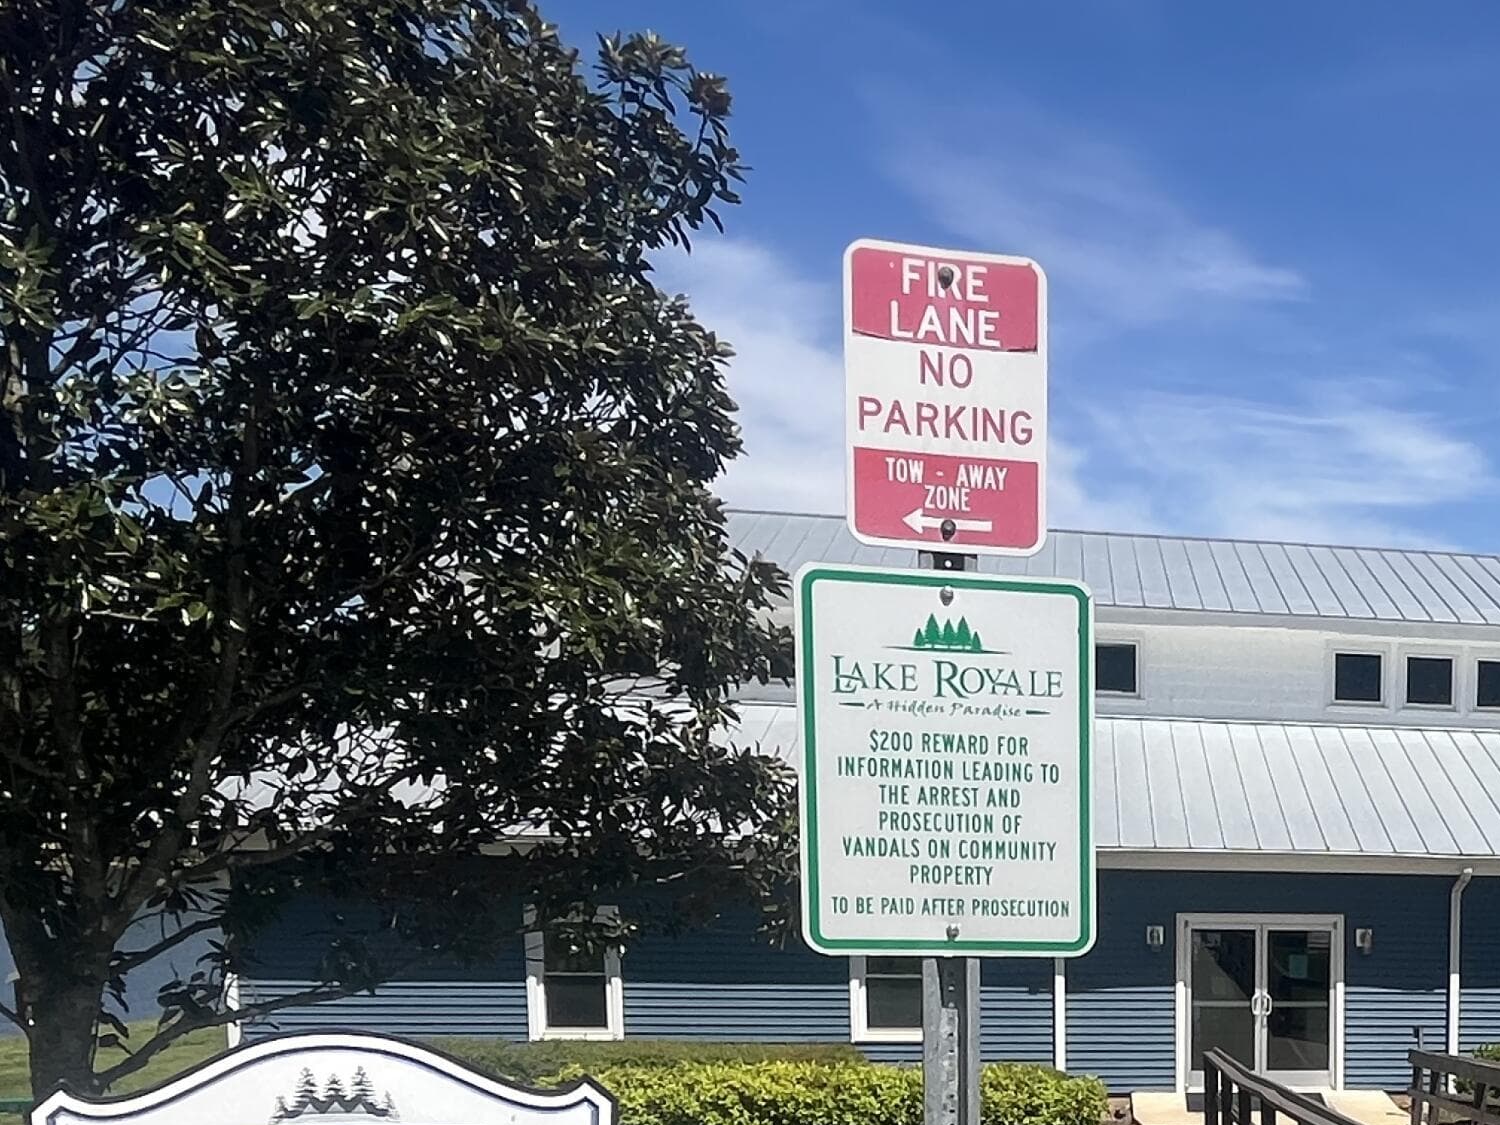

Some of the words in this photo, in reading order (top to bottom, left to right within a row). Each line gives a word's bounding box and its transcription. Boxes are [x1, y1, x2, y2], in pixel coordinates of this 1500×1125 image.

[902, 258, 989, 302] FIRE
[890, 300, 1000, 347] LANE
[920, 350, 973, 389] NO
[858, 396, 1033, 445] PARKING
[885, 457, 923, 484] TOW
[956, 466, 1008, 491] AWAY
[924, 485, 970, 512] ZONE
[831, 654, 918, 694] LAKE
[933, 659, 1064, 699] ROYALE
[949, 704, 1021, 719] Paradise
[869, 729, 913, 752] $200
[922, 734, 989, 755] REWARD
[999, 736, 1028, 757] FOR
[837, 756, 953, 780] INFORMATION
[962, 761, 1033, 782] LEADING
[1041, 764, 1060, 784] TO
[879, 784, 909, 805] THE
[918, 786, 979, 807] ARREST
[986, 788, 1021, 808] AND
[879, 811, 993, 834] PROSECUTION
[1002, 815, 1023, 834] OF
[842, 837, 920, 858] VANDALS
[928, 839, 950, 859] ON
[959, 841, 1057, 861] COMMUNITY
[910, 865, 993, 886] PROPERTY
[832, 897, 848, 914] TO
[856, 897, 874, 914] BE
[881, 897, 915, 915] PAID
[921, 898, 964, 916] AFTER
[972, 900, 1070, 918] PROSECUTION
